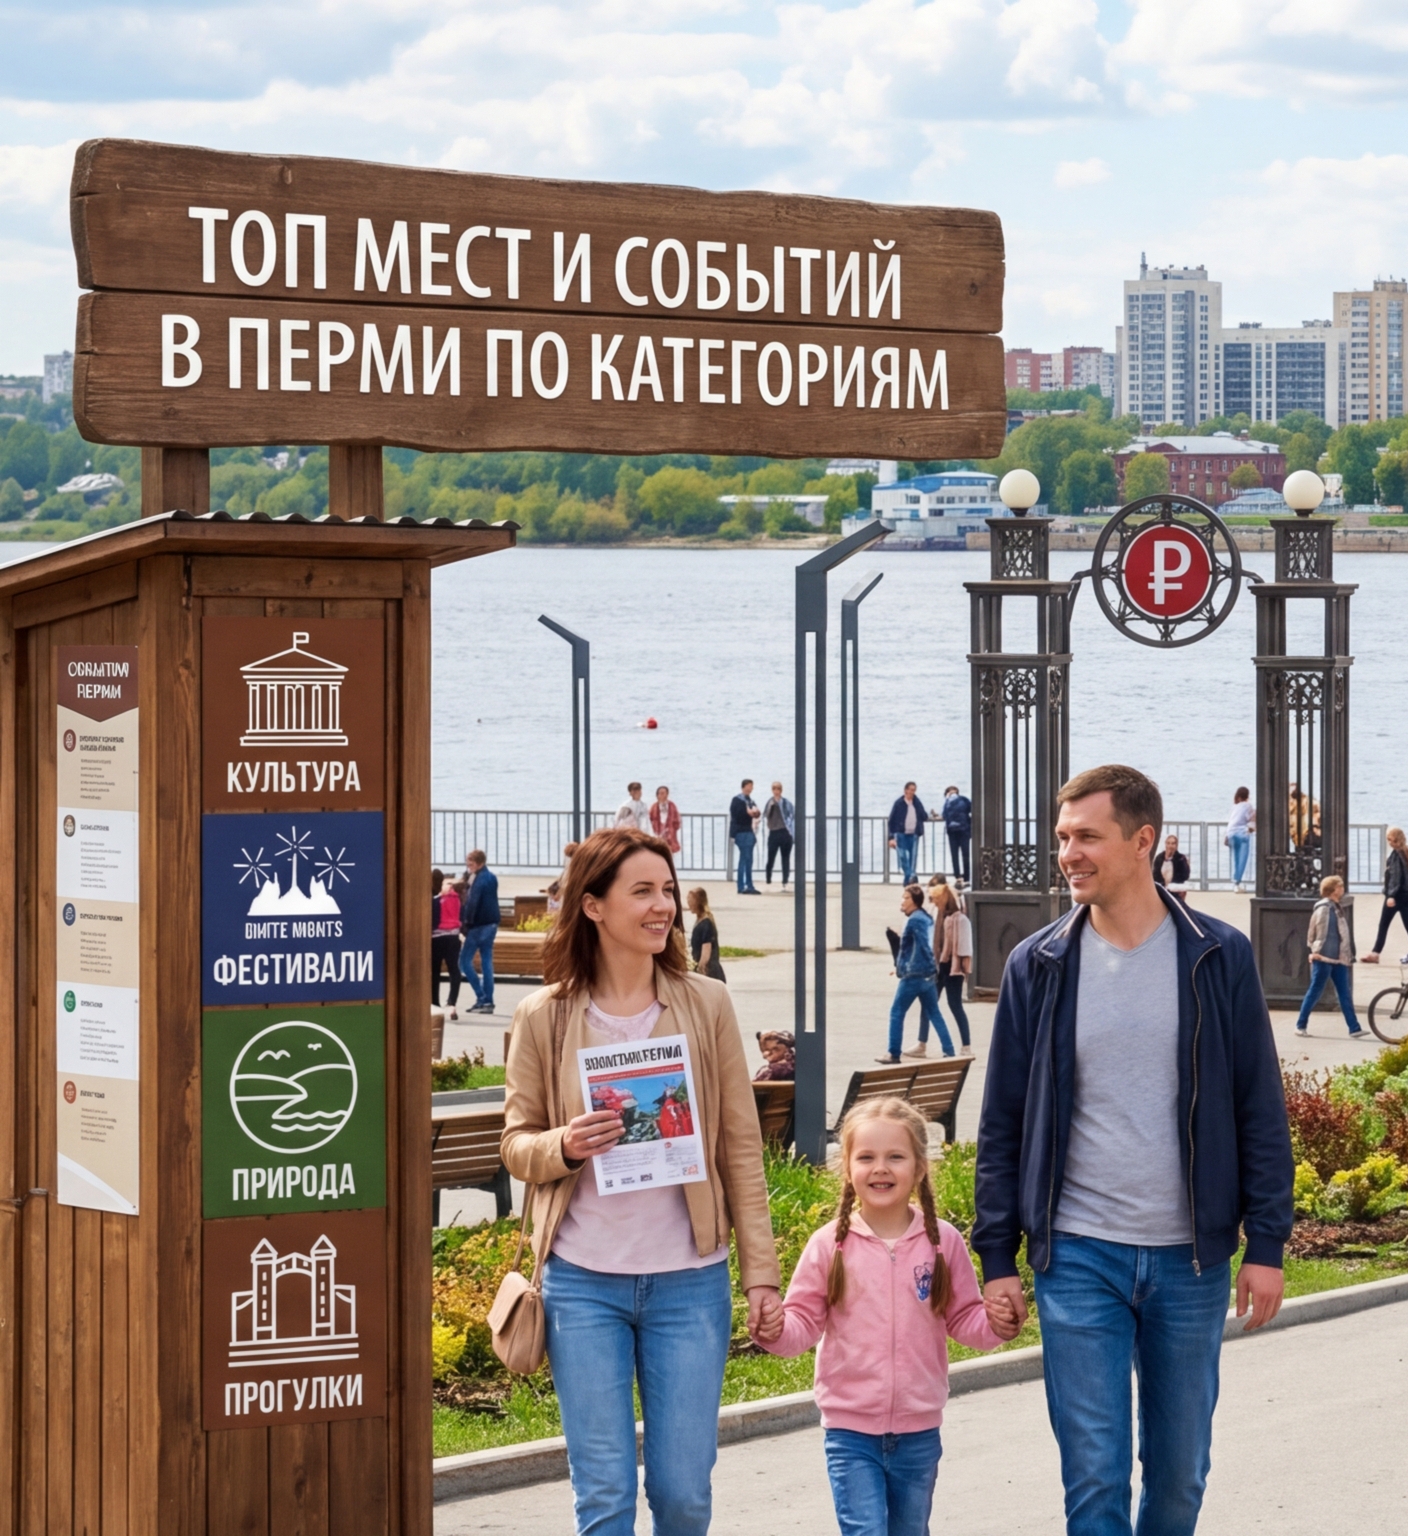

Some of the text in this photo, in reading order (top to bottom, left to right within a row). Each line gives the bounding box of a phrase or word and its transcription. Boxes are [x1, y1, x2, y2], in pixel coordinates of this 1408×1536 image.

[188, 206, 903, 320] ТОП МЕСТ И СОБЫТИЙ
[161, 313, 950, 411] В ПЕРМИ ПО КАТЕГОРИЯМ
[227, 761, 361, 793] КУЛЬТУРА
[213, 951, 374, 986] ФЕСТИВАЛИ
[232, 1163, 356, 1201] ПРИРОДА
[224, 1373, 363, 1416] ПРОГУЛКИ
